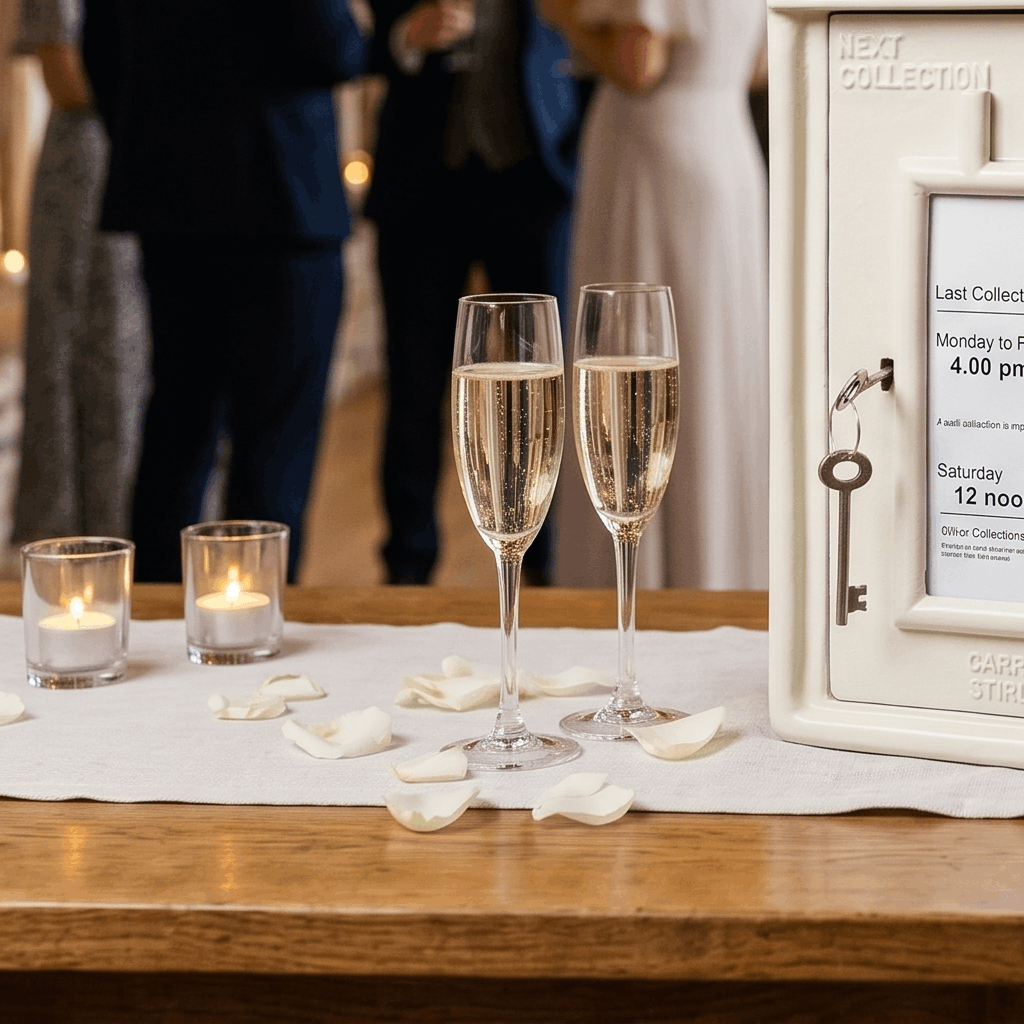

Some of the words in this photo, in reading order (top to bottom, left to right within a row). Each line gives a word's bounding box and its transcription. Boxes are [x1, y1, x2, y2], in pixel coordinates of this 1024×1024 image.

[838, 32, 905, 60] NEXT
[840, 61, 991, 91] COLLECTION
[935, 284, 968, 301] Last
[936, 332, 995, 353] Monday
[998, 336, 1013, 351] to
[950, 356, 992, 376] 4.00
[937, 462, 1003, 484] Saturday
[954, 485, 977, 505] 12
